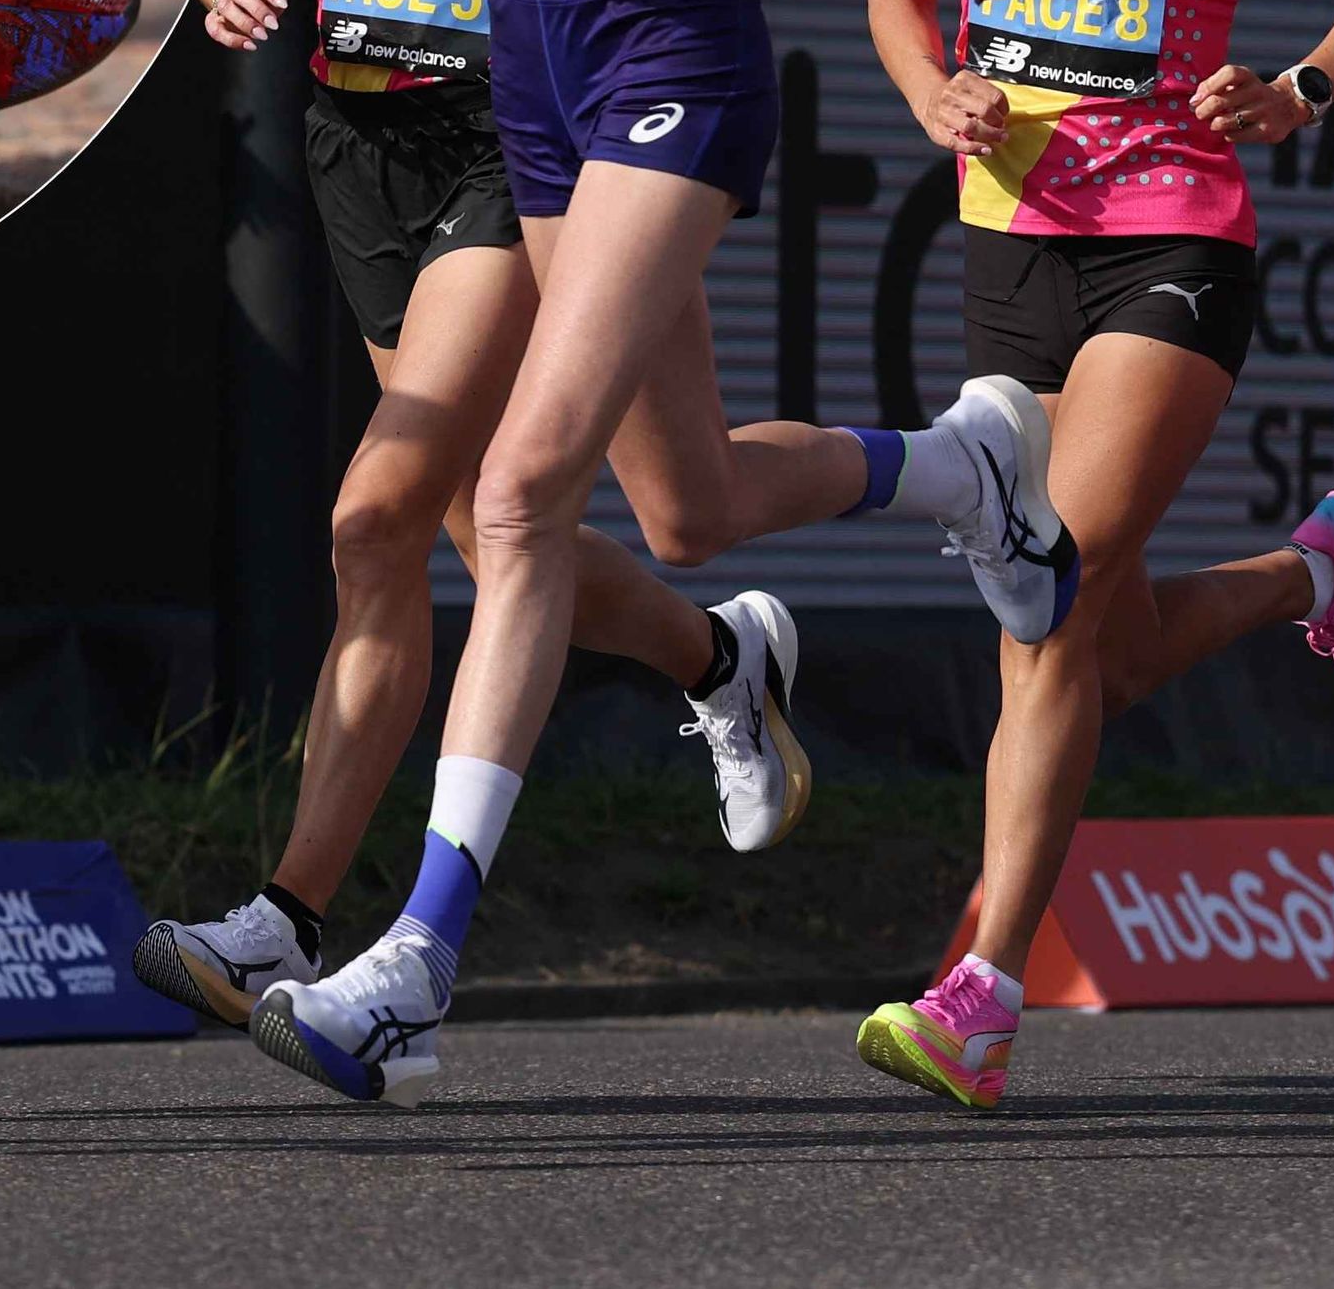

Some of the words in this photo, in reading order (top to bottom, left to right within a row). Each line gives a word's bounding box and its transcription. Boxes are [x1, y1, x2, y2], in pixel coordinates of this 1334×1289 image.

[365, 43, 396, 59] new
[398, 45, 467, 70] balance
[1029, 64, 1061, 80] new
[1064, 67, 1135, 91] balance
